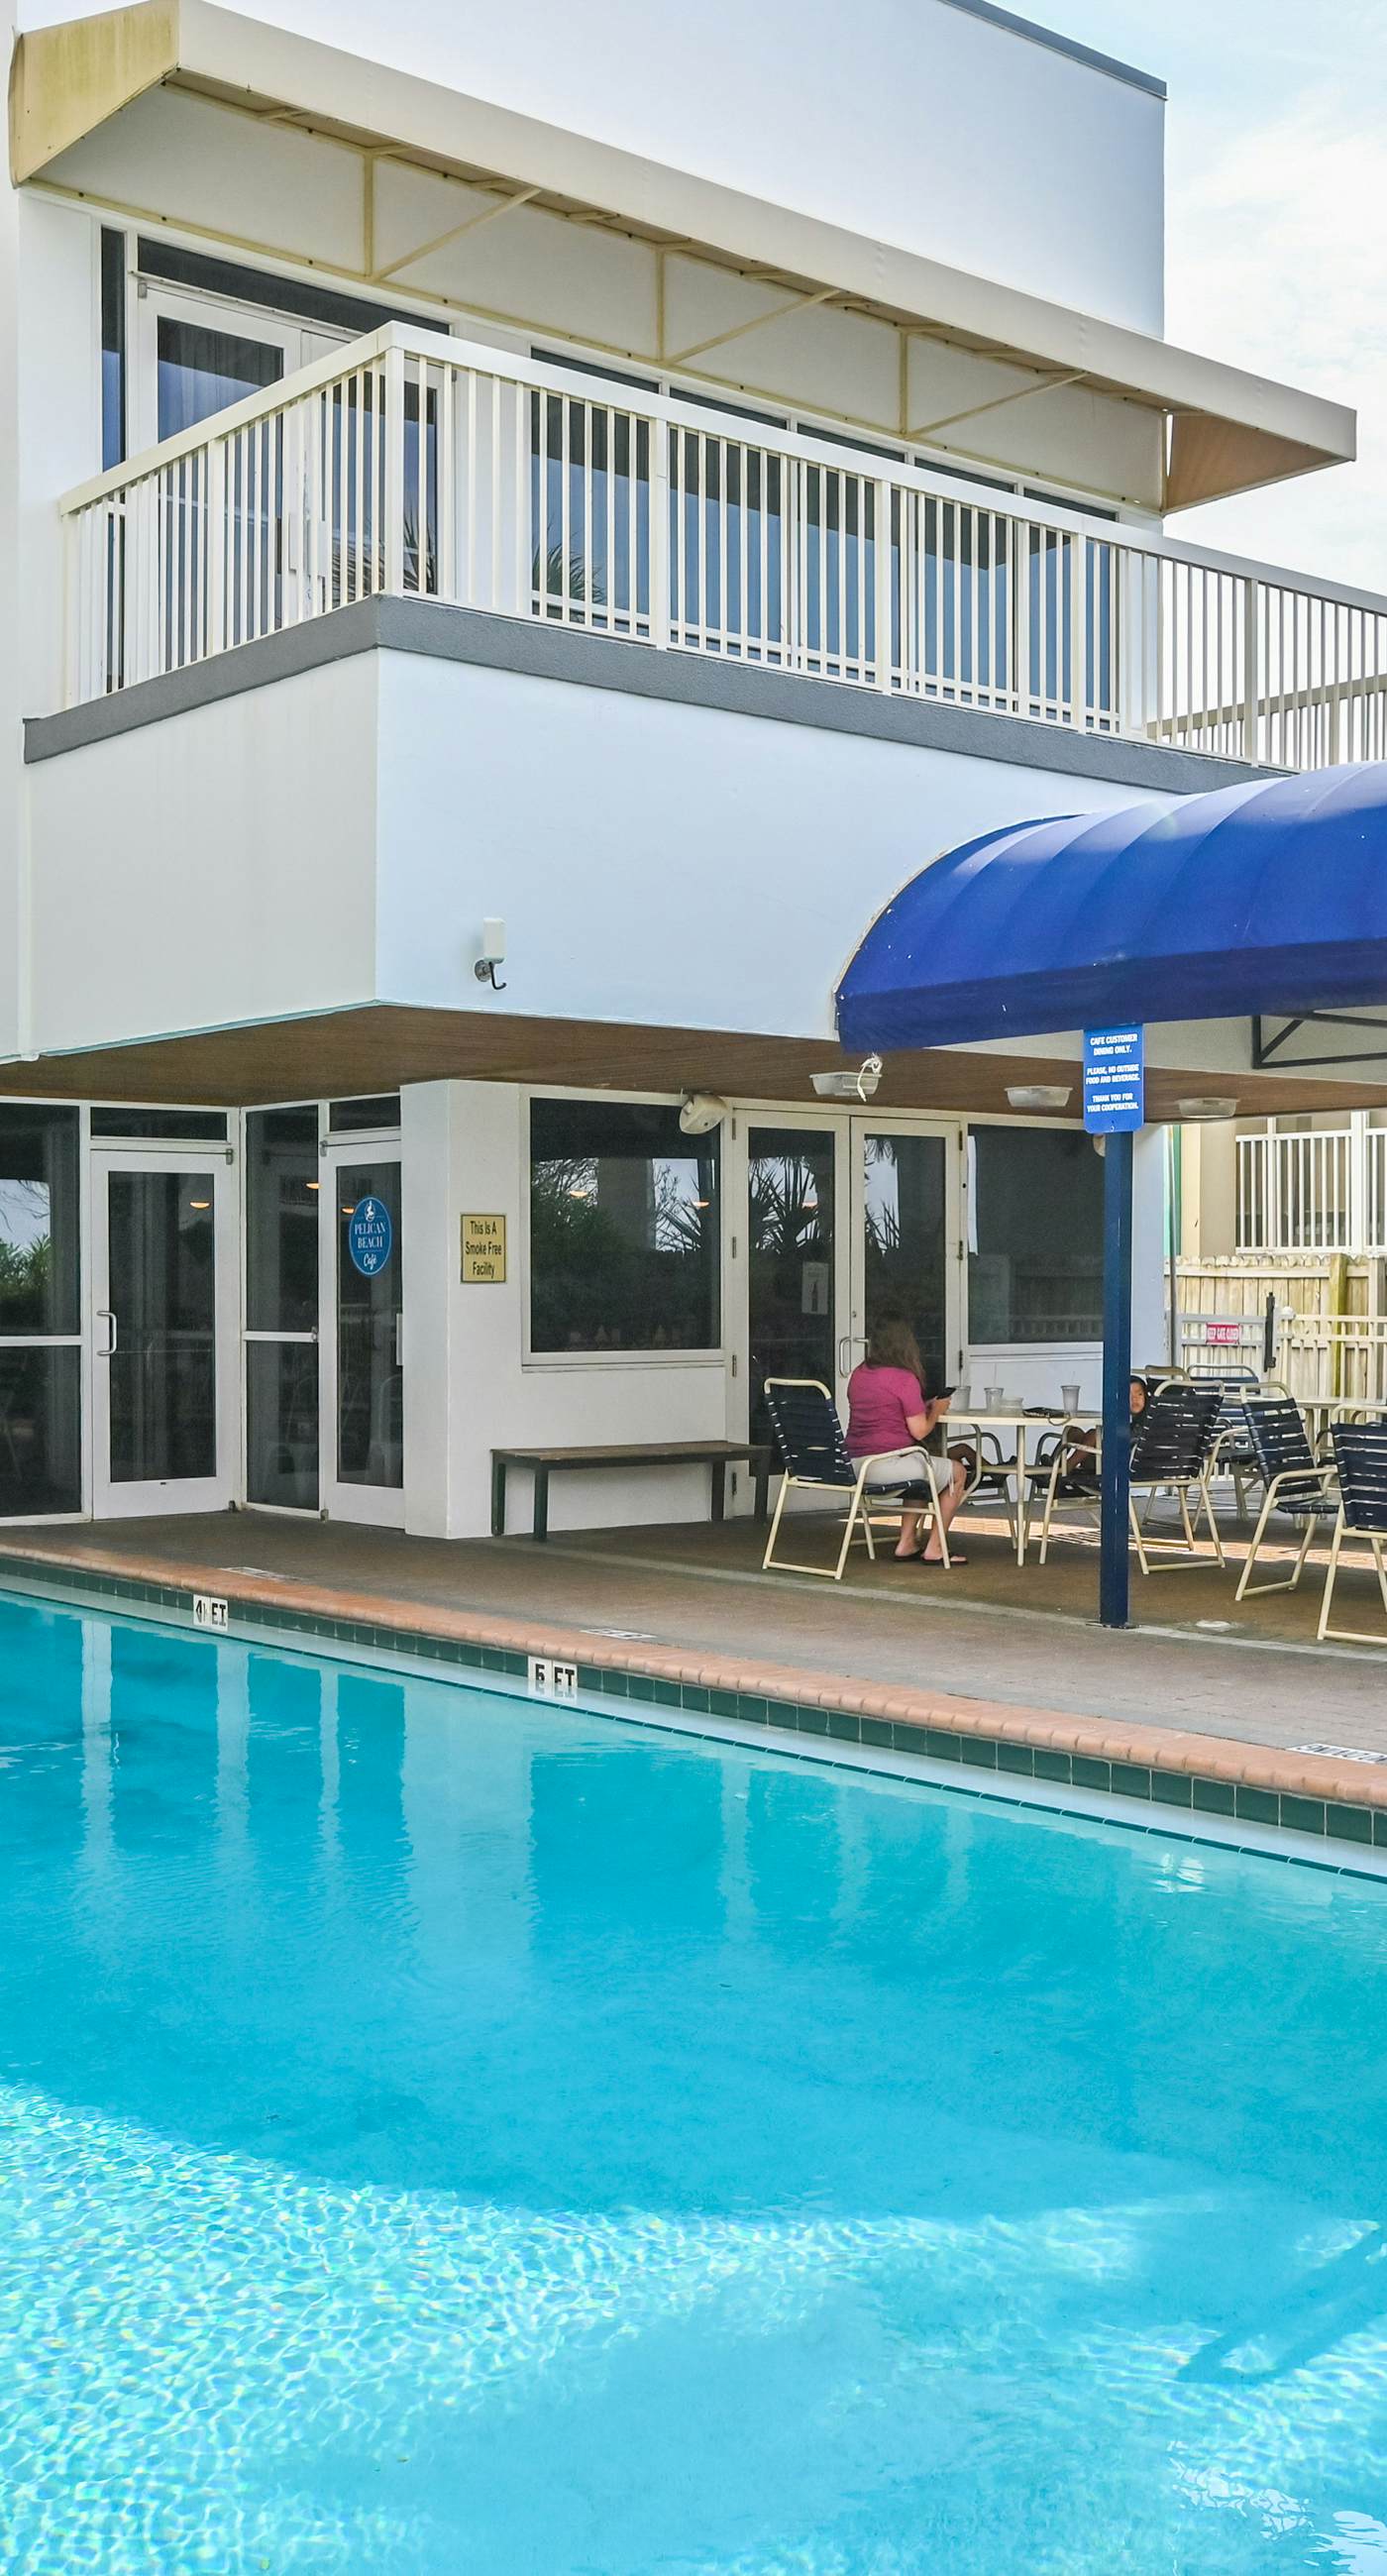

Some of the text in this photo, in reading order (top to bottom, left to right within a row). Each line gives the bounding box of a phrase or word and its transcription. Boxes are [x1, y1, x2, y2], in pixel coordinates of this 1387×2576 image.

[1090, 1033, 1138, 1046] CAFE CUSTOMER
[1115, 1044, 1132, 1054] ONLY.
[1108, 1065, 1117, 1074] NO
[1085, 1076, 1100, 1085] FOOD
[1100, 1075, 1111, 1084] AND
[1092, 1092, 1133, 1103] THANK YOU FOR
[1087, 1104, 1101, 1113] YOUR
[354, 1222, 386, 1235] PELICAN
[470, 1220, 497, 1235] This Is A
[358, 1235, 383, 1249] BEACH
[466, 1240, 502, 1255] Smoke Free
[473, 1260, 495, 1279] Facility
